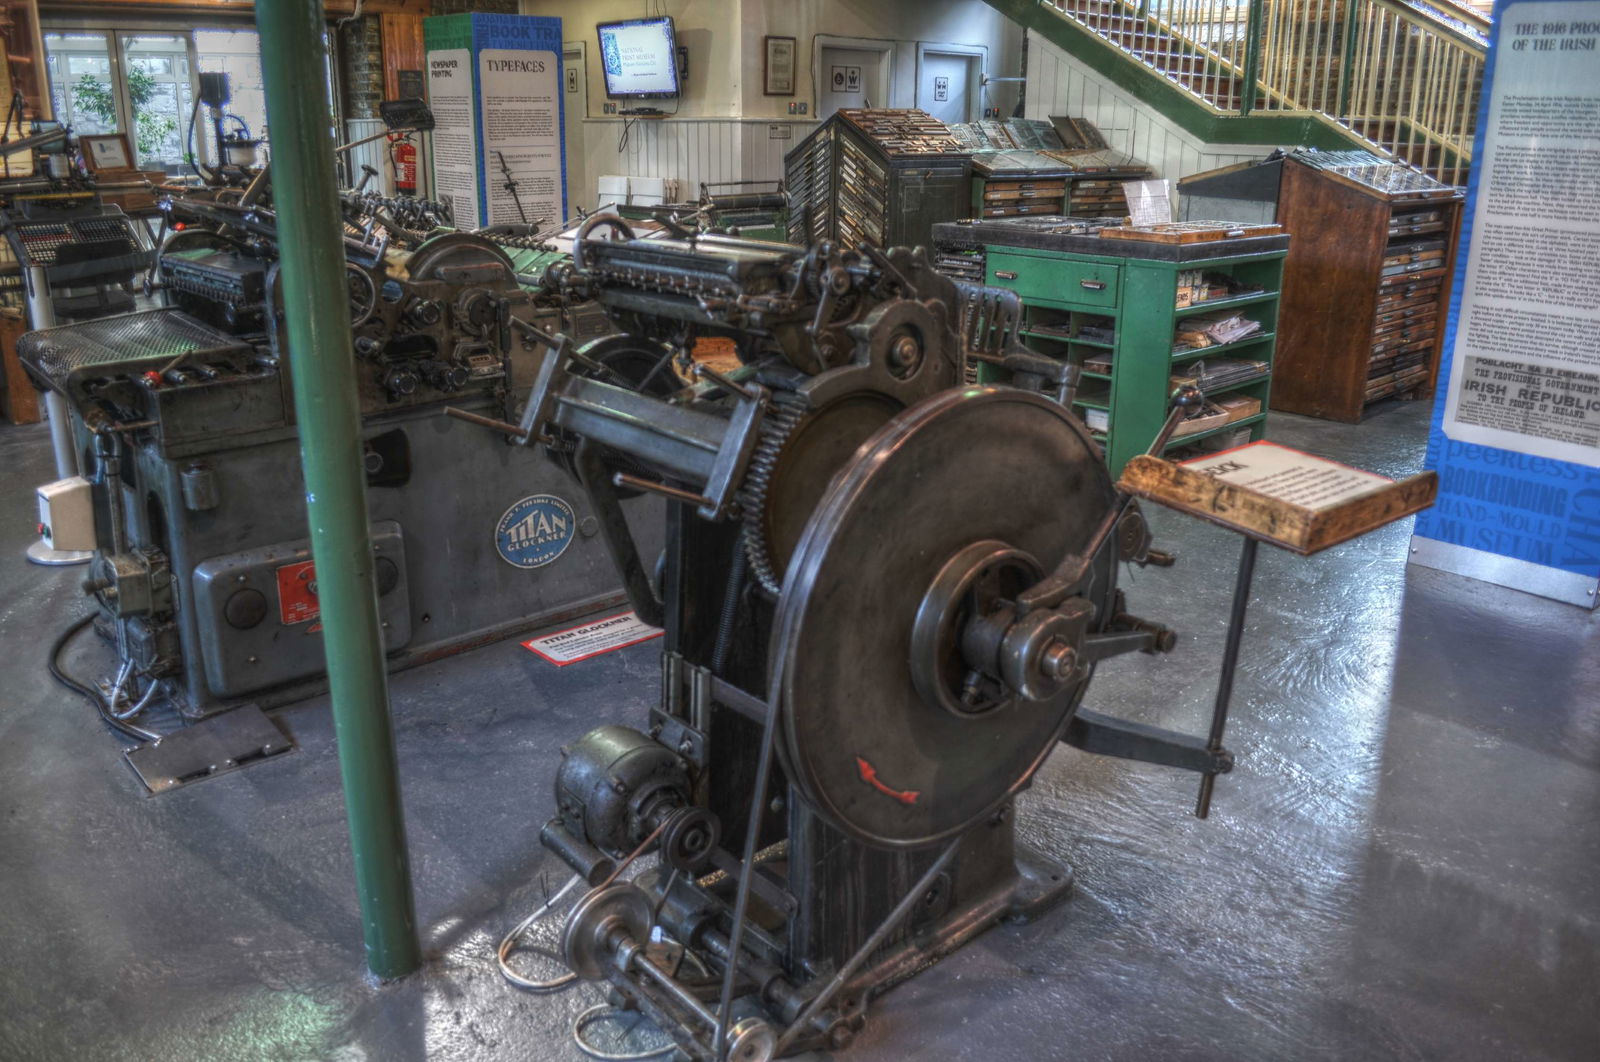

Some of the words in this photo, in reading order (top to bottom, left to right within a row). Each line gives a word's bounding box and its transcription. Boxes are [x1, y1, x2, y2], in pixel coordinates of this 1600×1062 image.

[490, 26, 530, 38] BOOK
[1514, 23, 1539, 35] THE
[1542, 22, 1566, 34] 1916
[1512, 39, 1528, 51] OF
[1534, 39, 1556, 51] THE
[1560, 38, 1596, 50] IRISH
[431, 60, 458, 69] NEWSPAPER
[432, 70, 452, 78] PRINTING
[487, 60, 545, 72] TYPEFACES
[1476, 357, 1524, 370] POBLACHT
[1474, 368, 1490, 378] THE
[1494, 371, 1541, 386] PROVISIONAL
[1546, 379, 1600, 395] GOVERNMENT
[1464, 380, 1507, 396] IRISH
[1518, 388, 1600, 412] REPUBLIC
[1478, 393, 1487, 402] TO
[1491, 396, 1504, 405] THE
[1509, 399, 1535, 410] PEOPLE
[1538, 404, 1548, 412] OF
[1442, 464, 1568, 518] BOOKBINDING
[500, 512, 514, 532] FRANK
[1438, 498, 1562, 538] HAND-MOULD
[508, 531, 566, 552] GLOCKNER
[1435, 517, 1553, 563] MUSEUM
[524, 552, 554, 563] LONDON
[542, 632, 575, 644] TITAN
[578, 616, 633, 634] GLOCKNER
